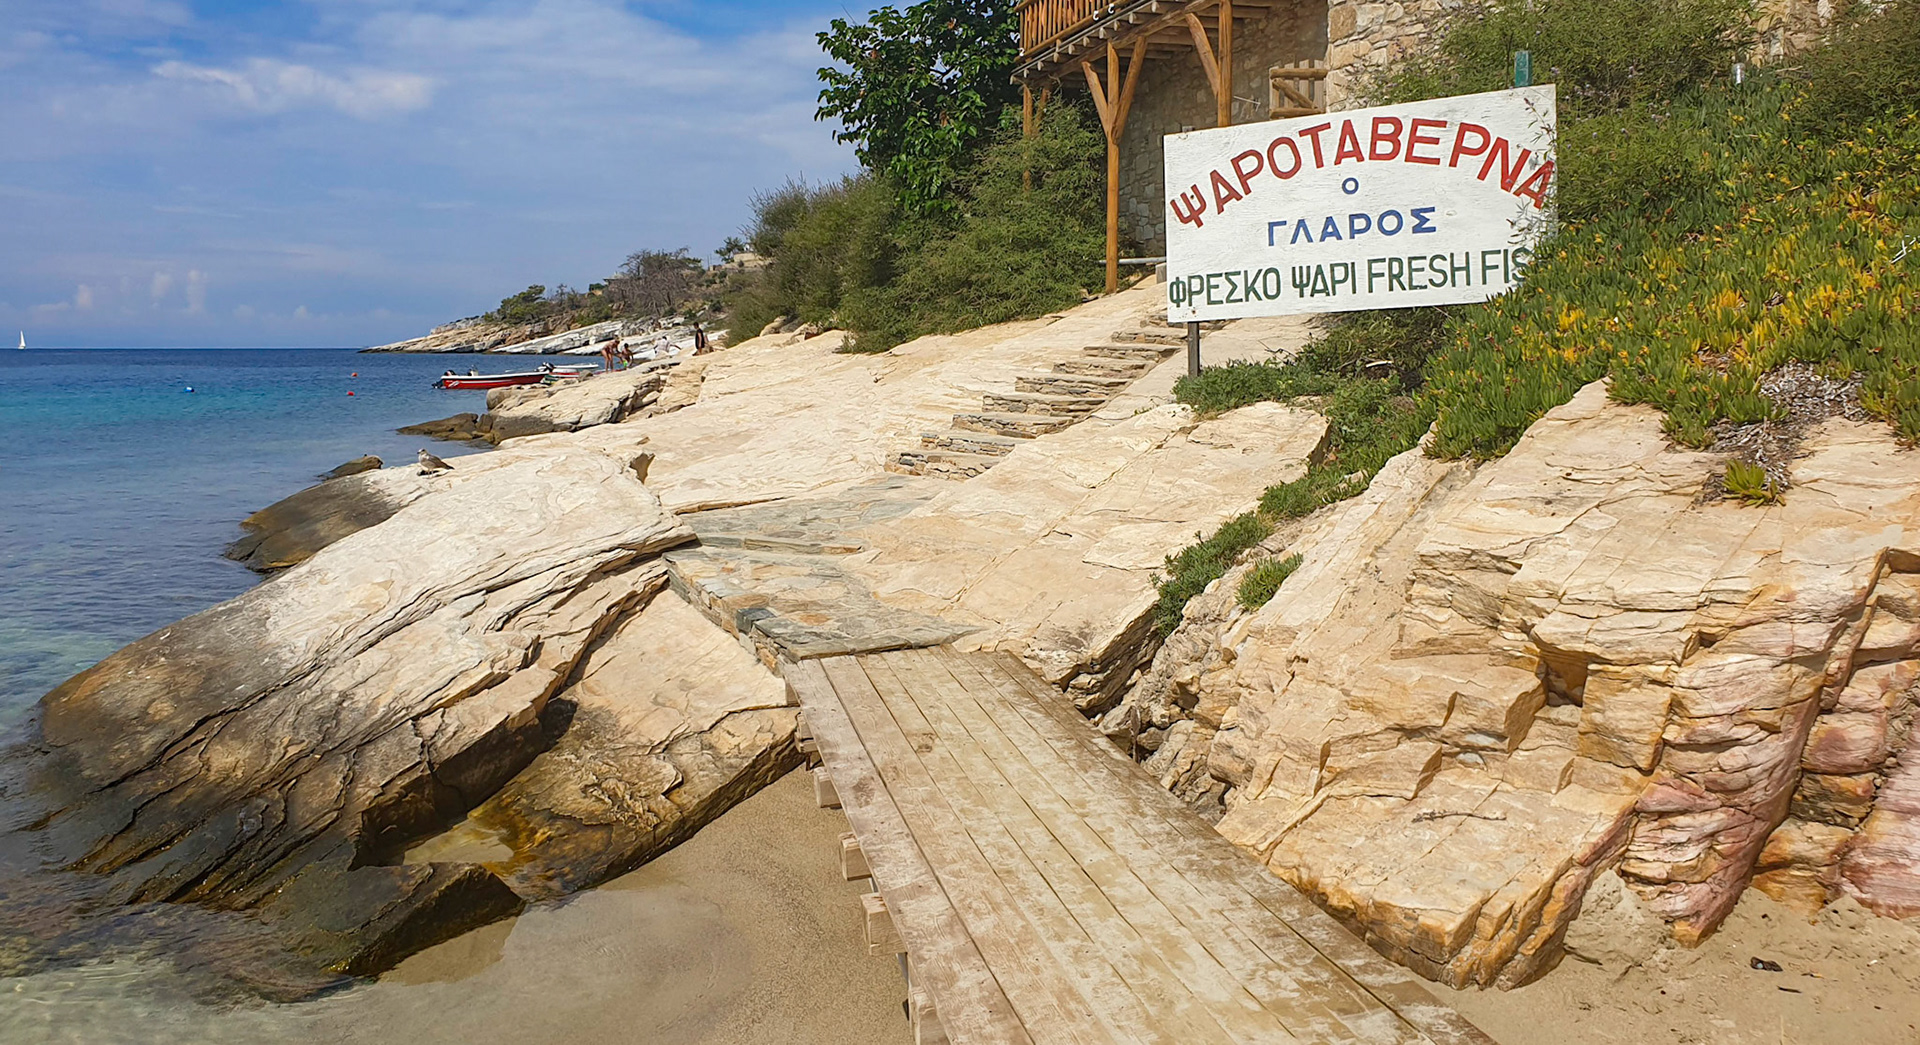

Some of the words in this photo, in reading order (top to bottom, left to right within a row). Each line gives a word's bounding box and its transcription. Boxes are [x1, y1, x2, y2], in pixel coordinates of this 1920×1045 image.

[1170, 117, 1554, 228] ΨΑΡΟΤΑΒΕΡΝΑ
[1268, 206, 1436, 246] ΓΛΑΡΟΣ
[1169, 267, 1281, 308] ΦΡΕΣΚΟ
[1292, 261, 1357, 298] ΨΑΡΙ
[1367, 252, 1471, 293] FRESH
[1481, 247, 1531, 286] FIS
